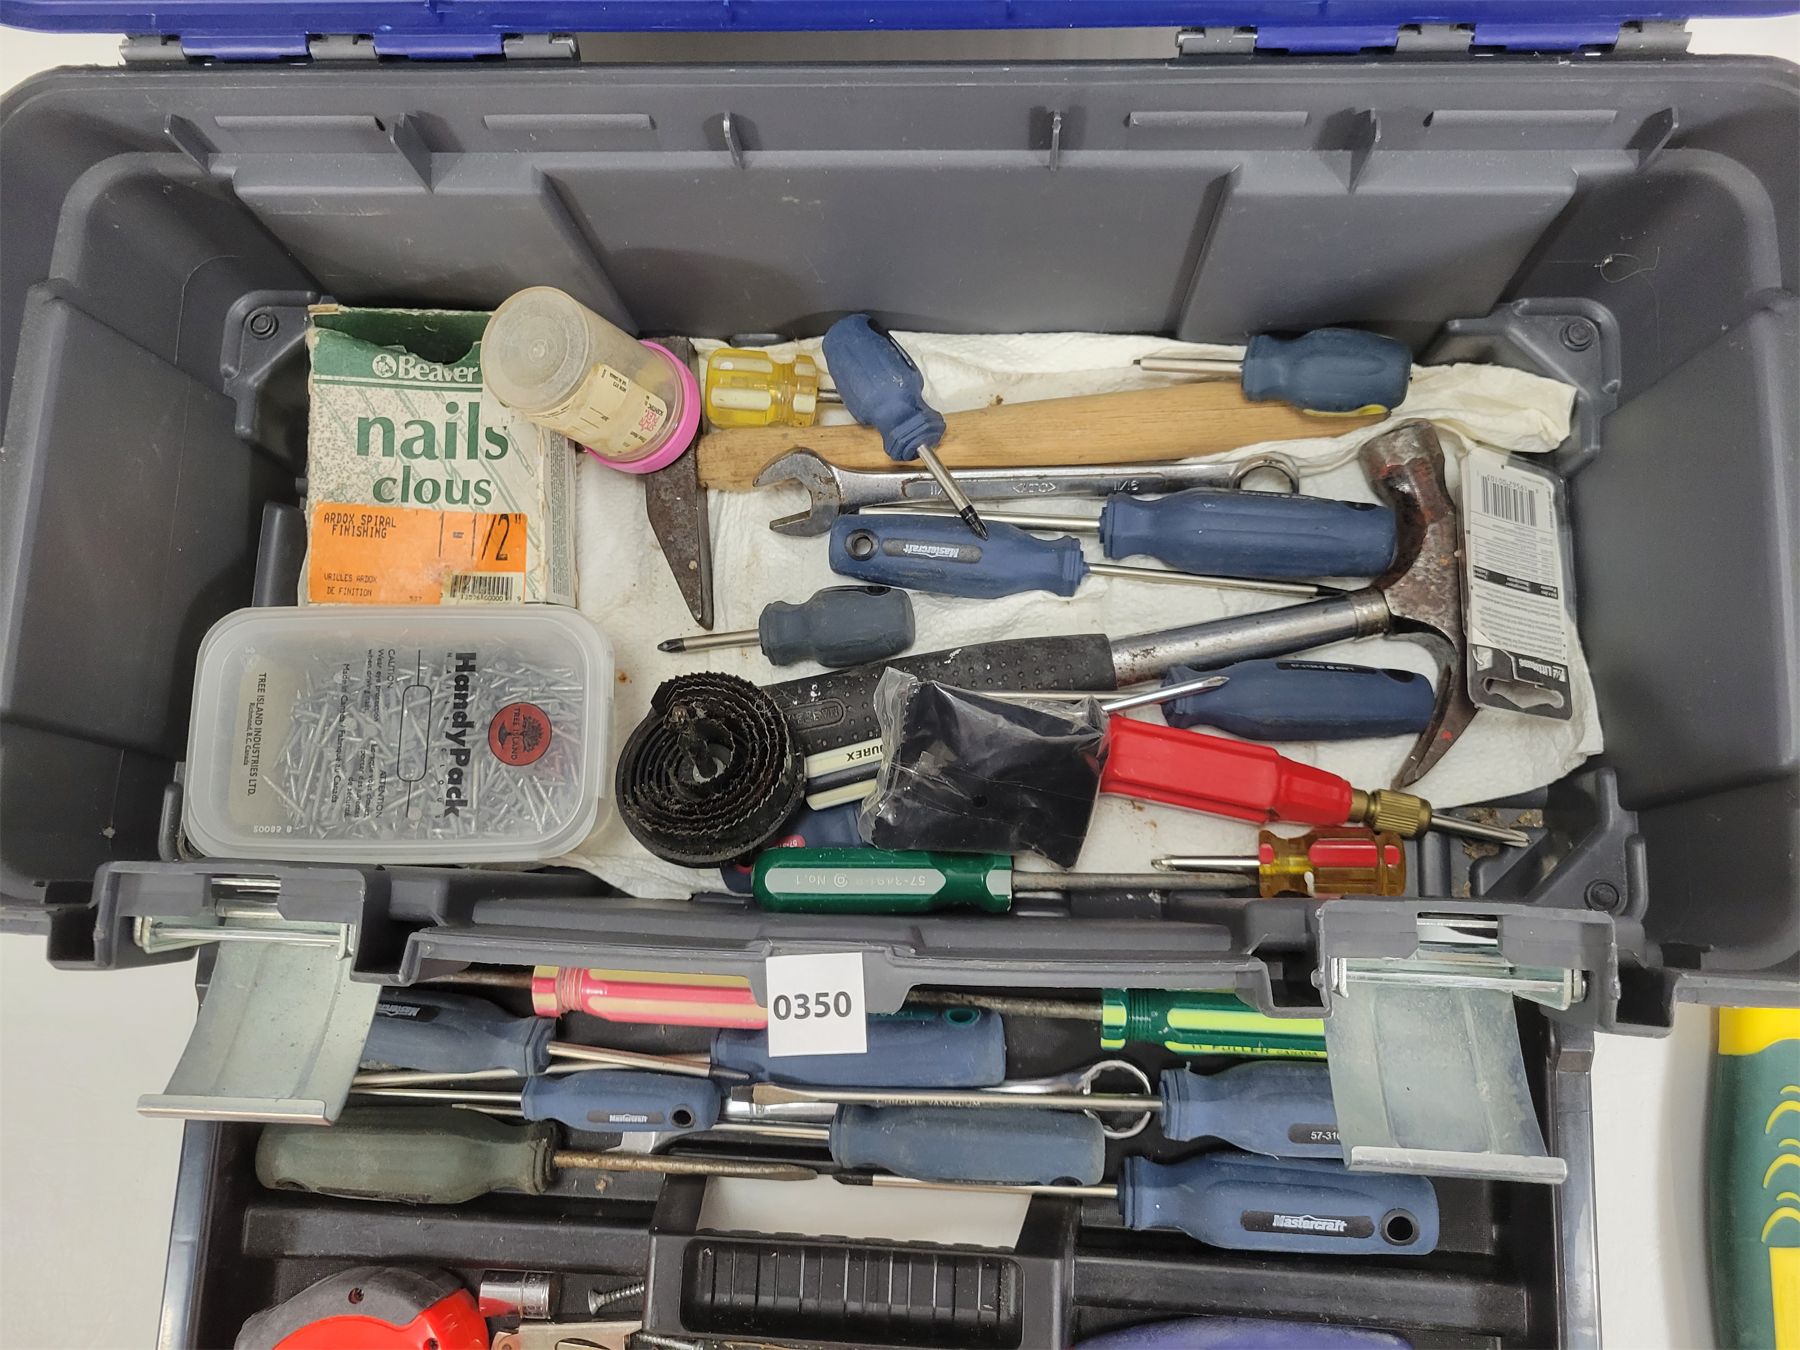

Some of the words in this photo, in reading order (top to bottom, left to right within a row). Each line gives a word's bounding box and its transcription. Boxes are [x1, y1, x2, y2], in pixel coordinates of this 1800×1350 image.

[398, 354, 478, 382] Beaver
[356, 401, 509, 460] nails
[372, 465, 492, 505] clous
[323, 512, 354, 525] ARDOX
[361, 515, 397, 528] SPIRAL
[331, 525, 387, 539] FINISHING
[902, 544, 960, 558] Mastercraft
[376, 648, 385, 669] Wear
[386, 648, 396, 689] CAUTION
[257, 672, 267, 693] TREE
[254, 694, 265, 725] ISLAND
[512, 707, 521, 726] TREE
[443, 652, 477, 818] HandyPack
[243, 745, 252, 766] Canada
[249, 727, 263, 777] INDUSTRIES
[247, 778, 257, 797] LTD.
[376, 770, 387, 818] ATTENTION
[773, 991, 852, 1021] 0350
[1272, 1214, 1347, 1232] Mastercraft
